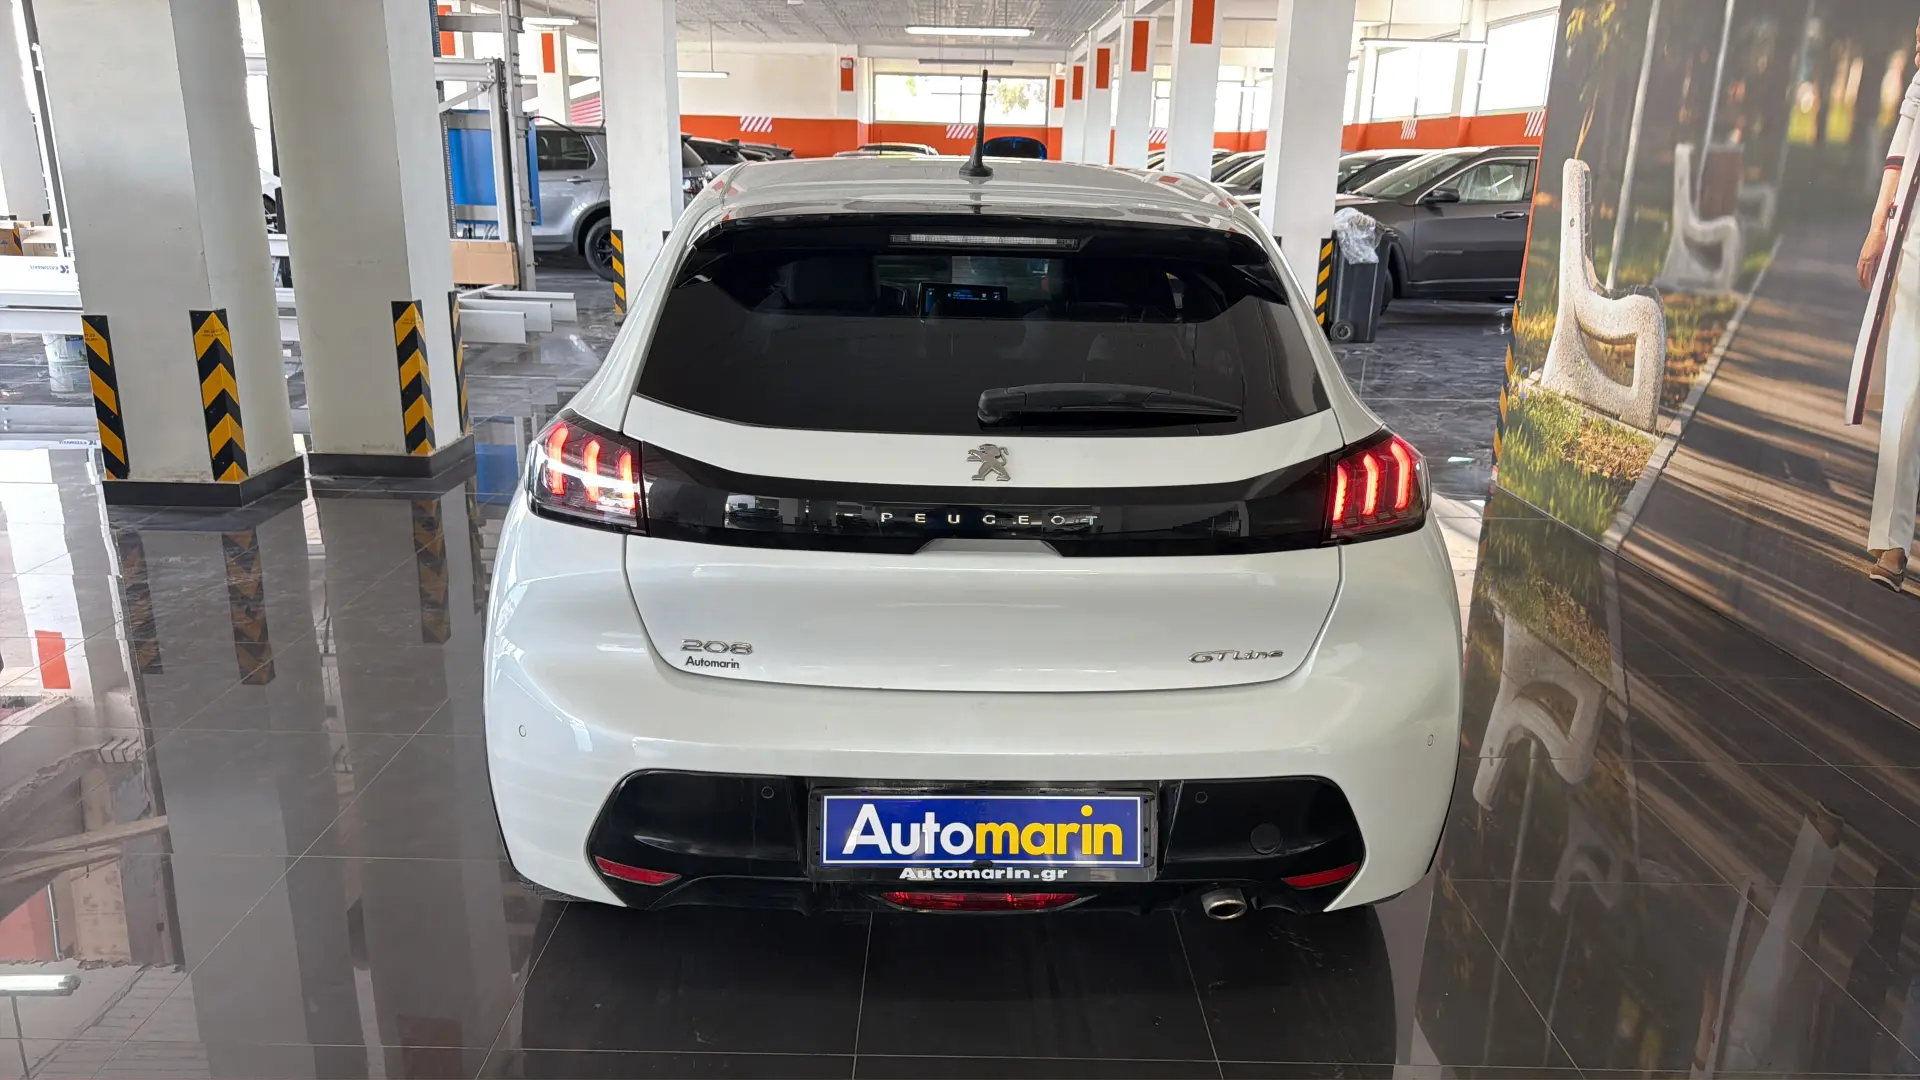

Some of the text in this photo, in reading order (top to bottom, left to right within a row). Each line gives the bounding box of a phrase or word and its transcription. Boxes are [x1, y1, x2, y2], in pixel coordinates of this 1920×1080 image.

[880, 512, 1098, 527] PEUGEOT
[681, 639, 752, 655] 208
[685, 656, 740, 669] Automarin
[841, 803, 1123, 855] Automarin
[899, 866, 1068, 882] Automarin.gr
